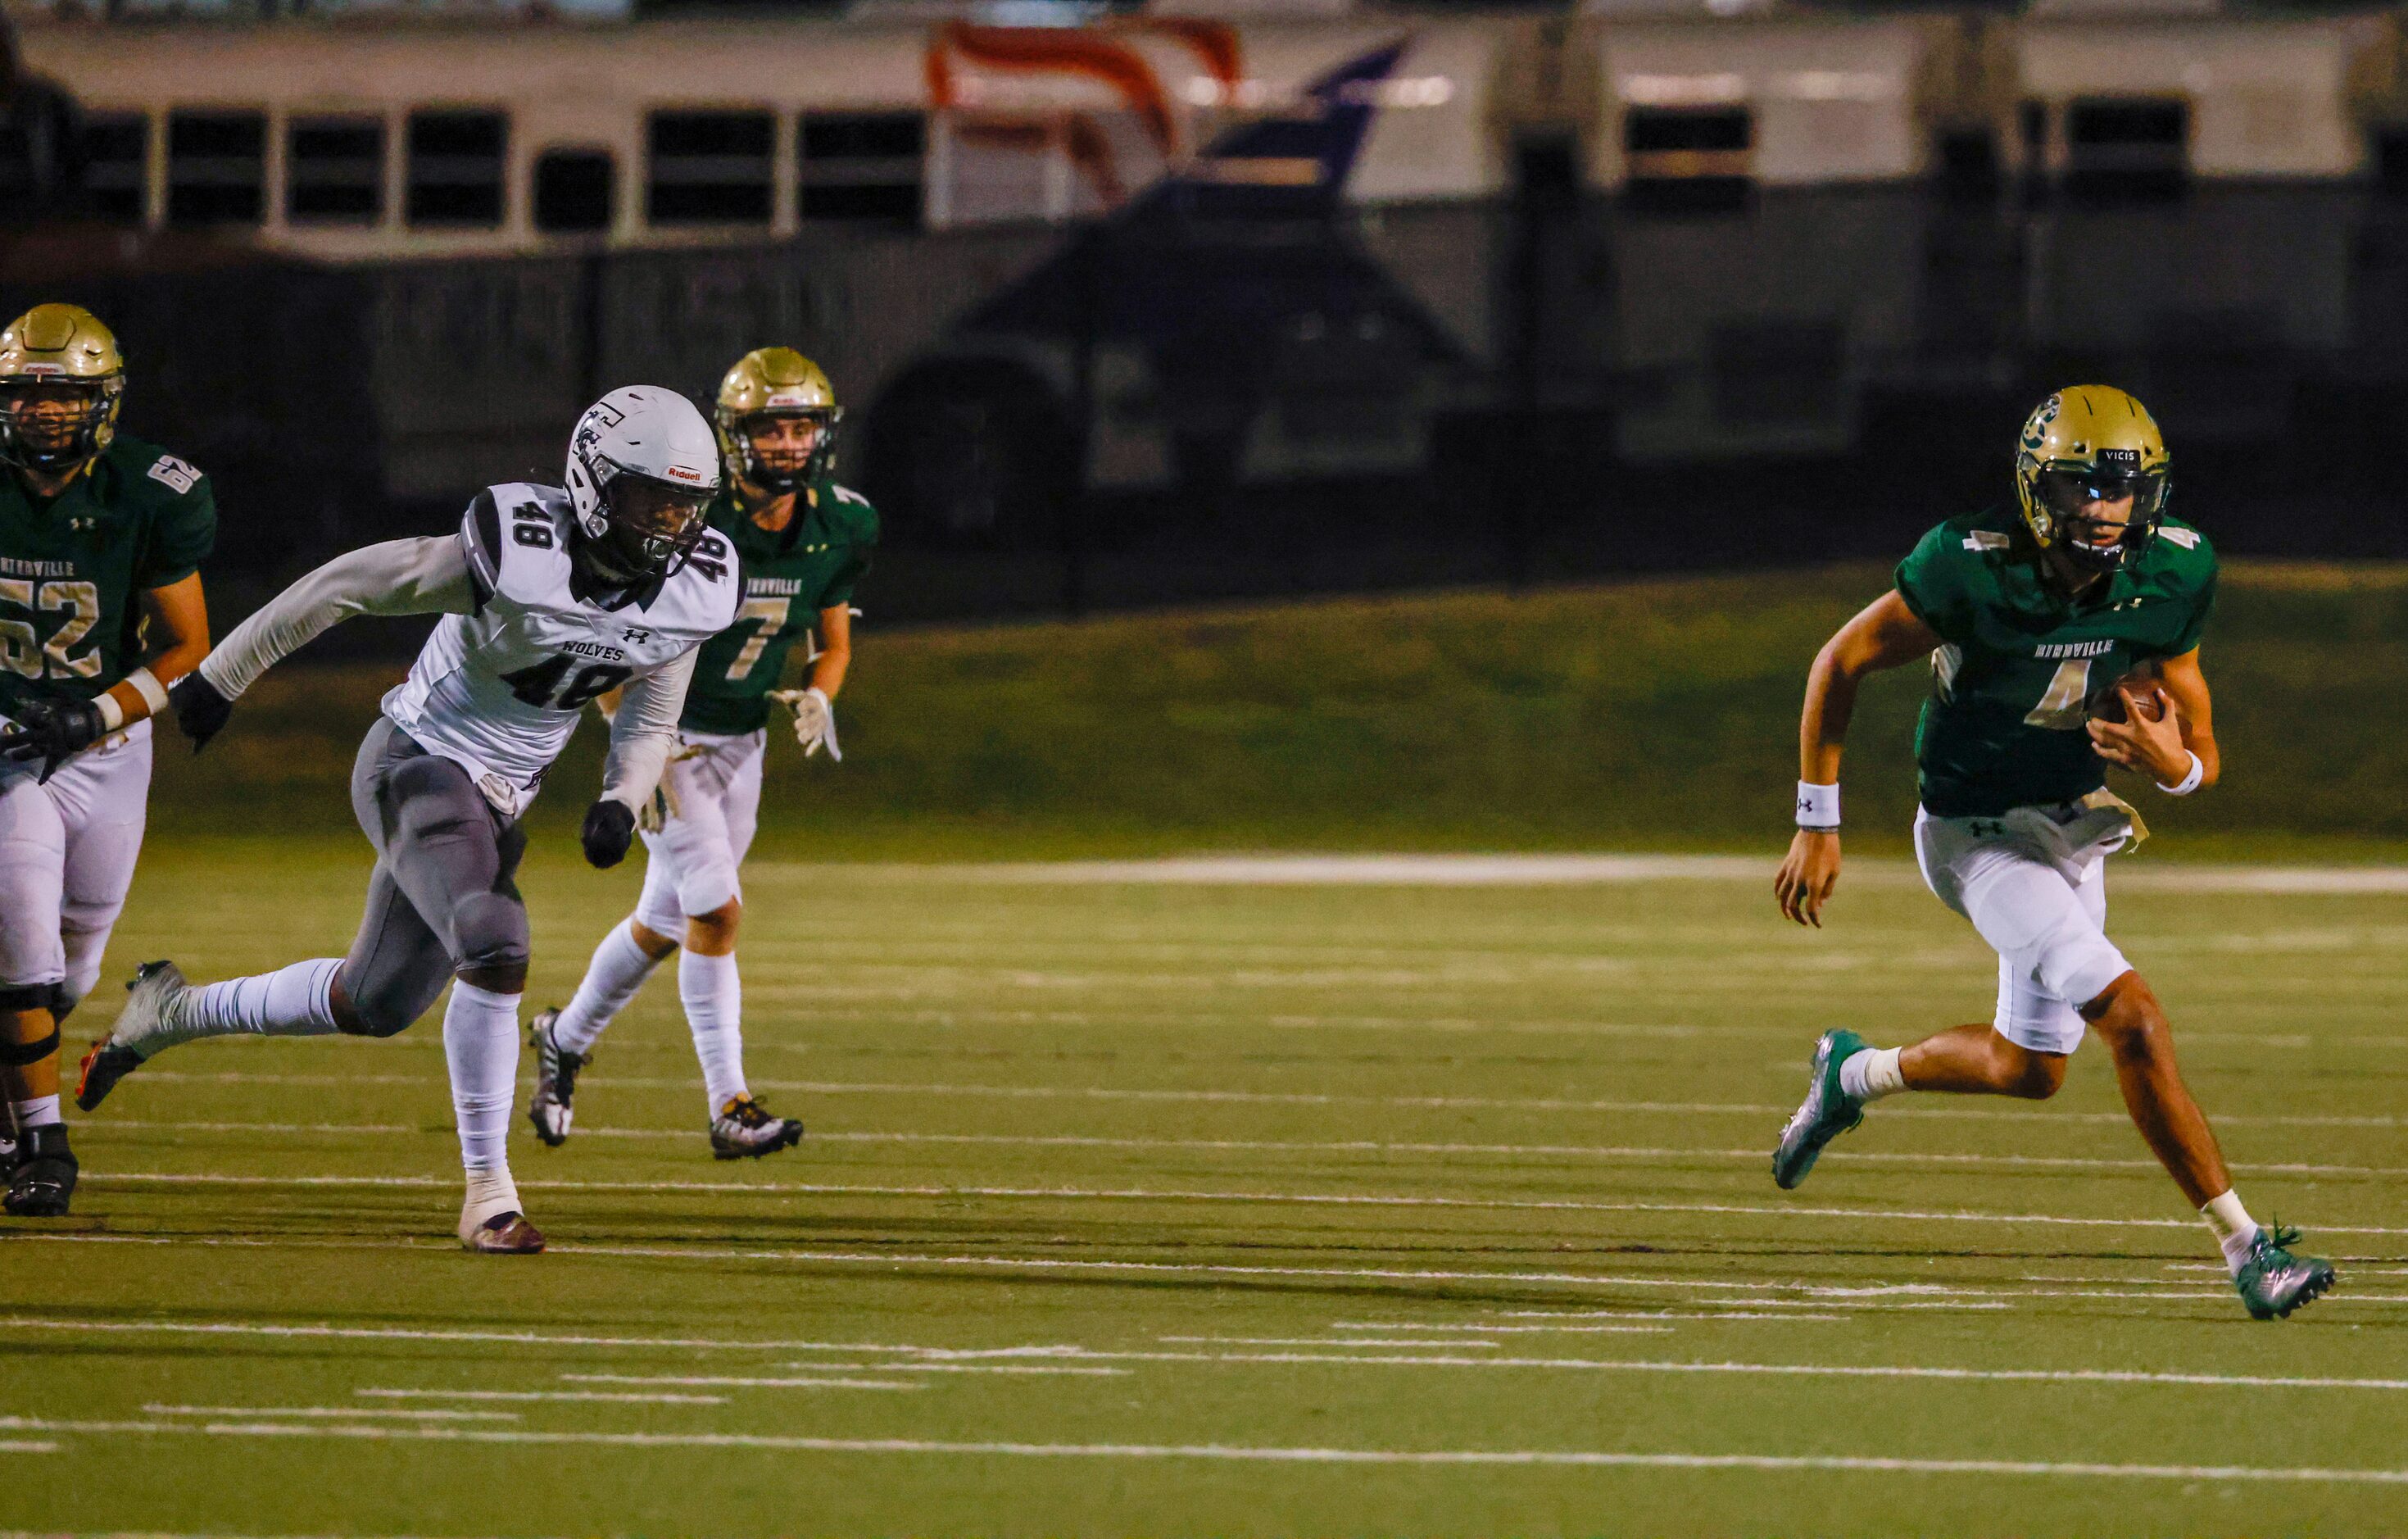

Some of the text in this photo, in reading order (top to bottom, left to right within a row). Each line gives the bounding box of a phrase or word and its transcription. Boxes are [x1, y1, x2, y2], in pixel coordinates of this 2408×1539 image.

[2106, 452, 2134, 461] VICIS
[147, 455, 203, 494] 62
[669, 467, 701, 481] Riddell
[513, 501, 554, 550] 48
[2157, 526, 2201, 550] 4
[562, 640, 624, 661] WOLVES
[725, 597, 791, 680] 7
[2034, 639, 2114, 658] BIRDVILLE
[497, 651, 634, 710] 48
[2023, 659, 2092, 730] 4
